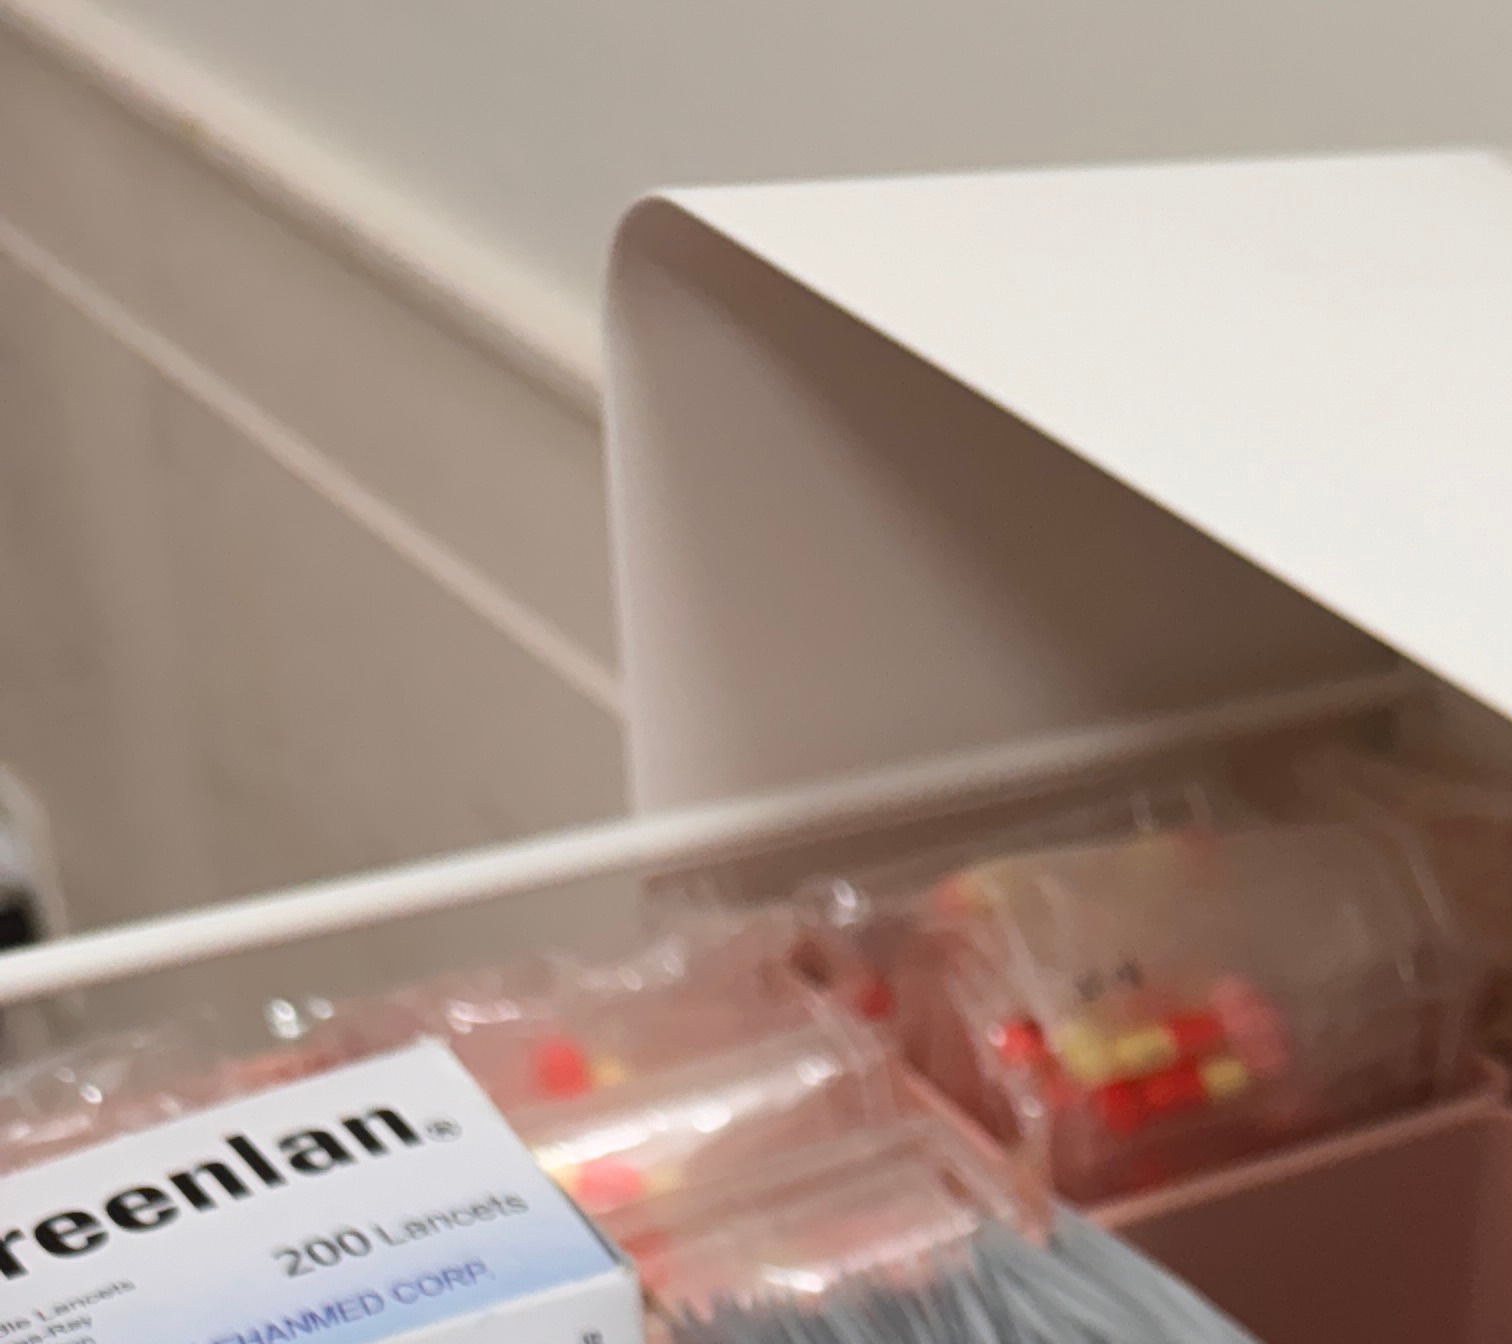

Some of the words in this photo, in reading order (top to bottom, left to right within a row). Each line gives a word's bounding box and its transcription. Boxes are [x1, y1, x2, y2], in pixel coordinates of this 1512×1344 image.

[0, 1102, 462, 1280] reenlan®
[273, 1228, 372, 1278] 200
[375, 1190, 530, 1250] Lancets
[35, 1280, 136, 1323] Lancets
[390, 1261, 498, 1308] CORP.
